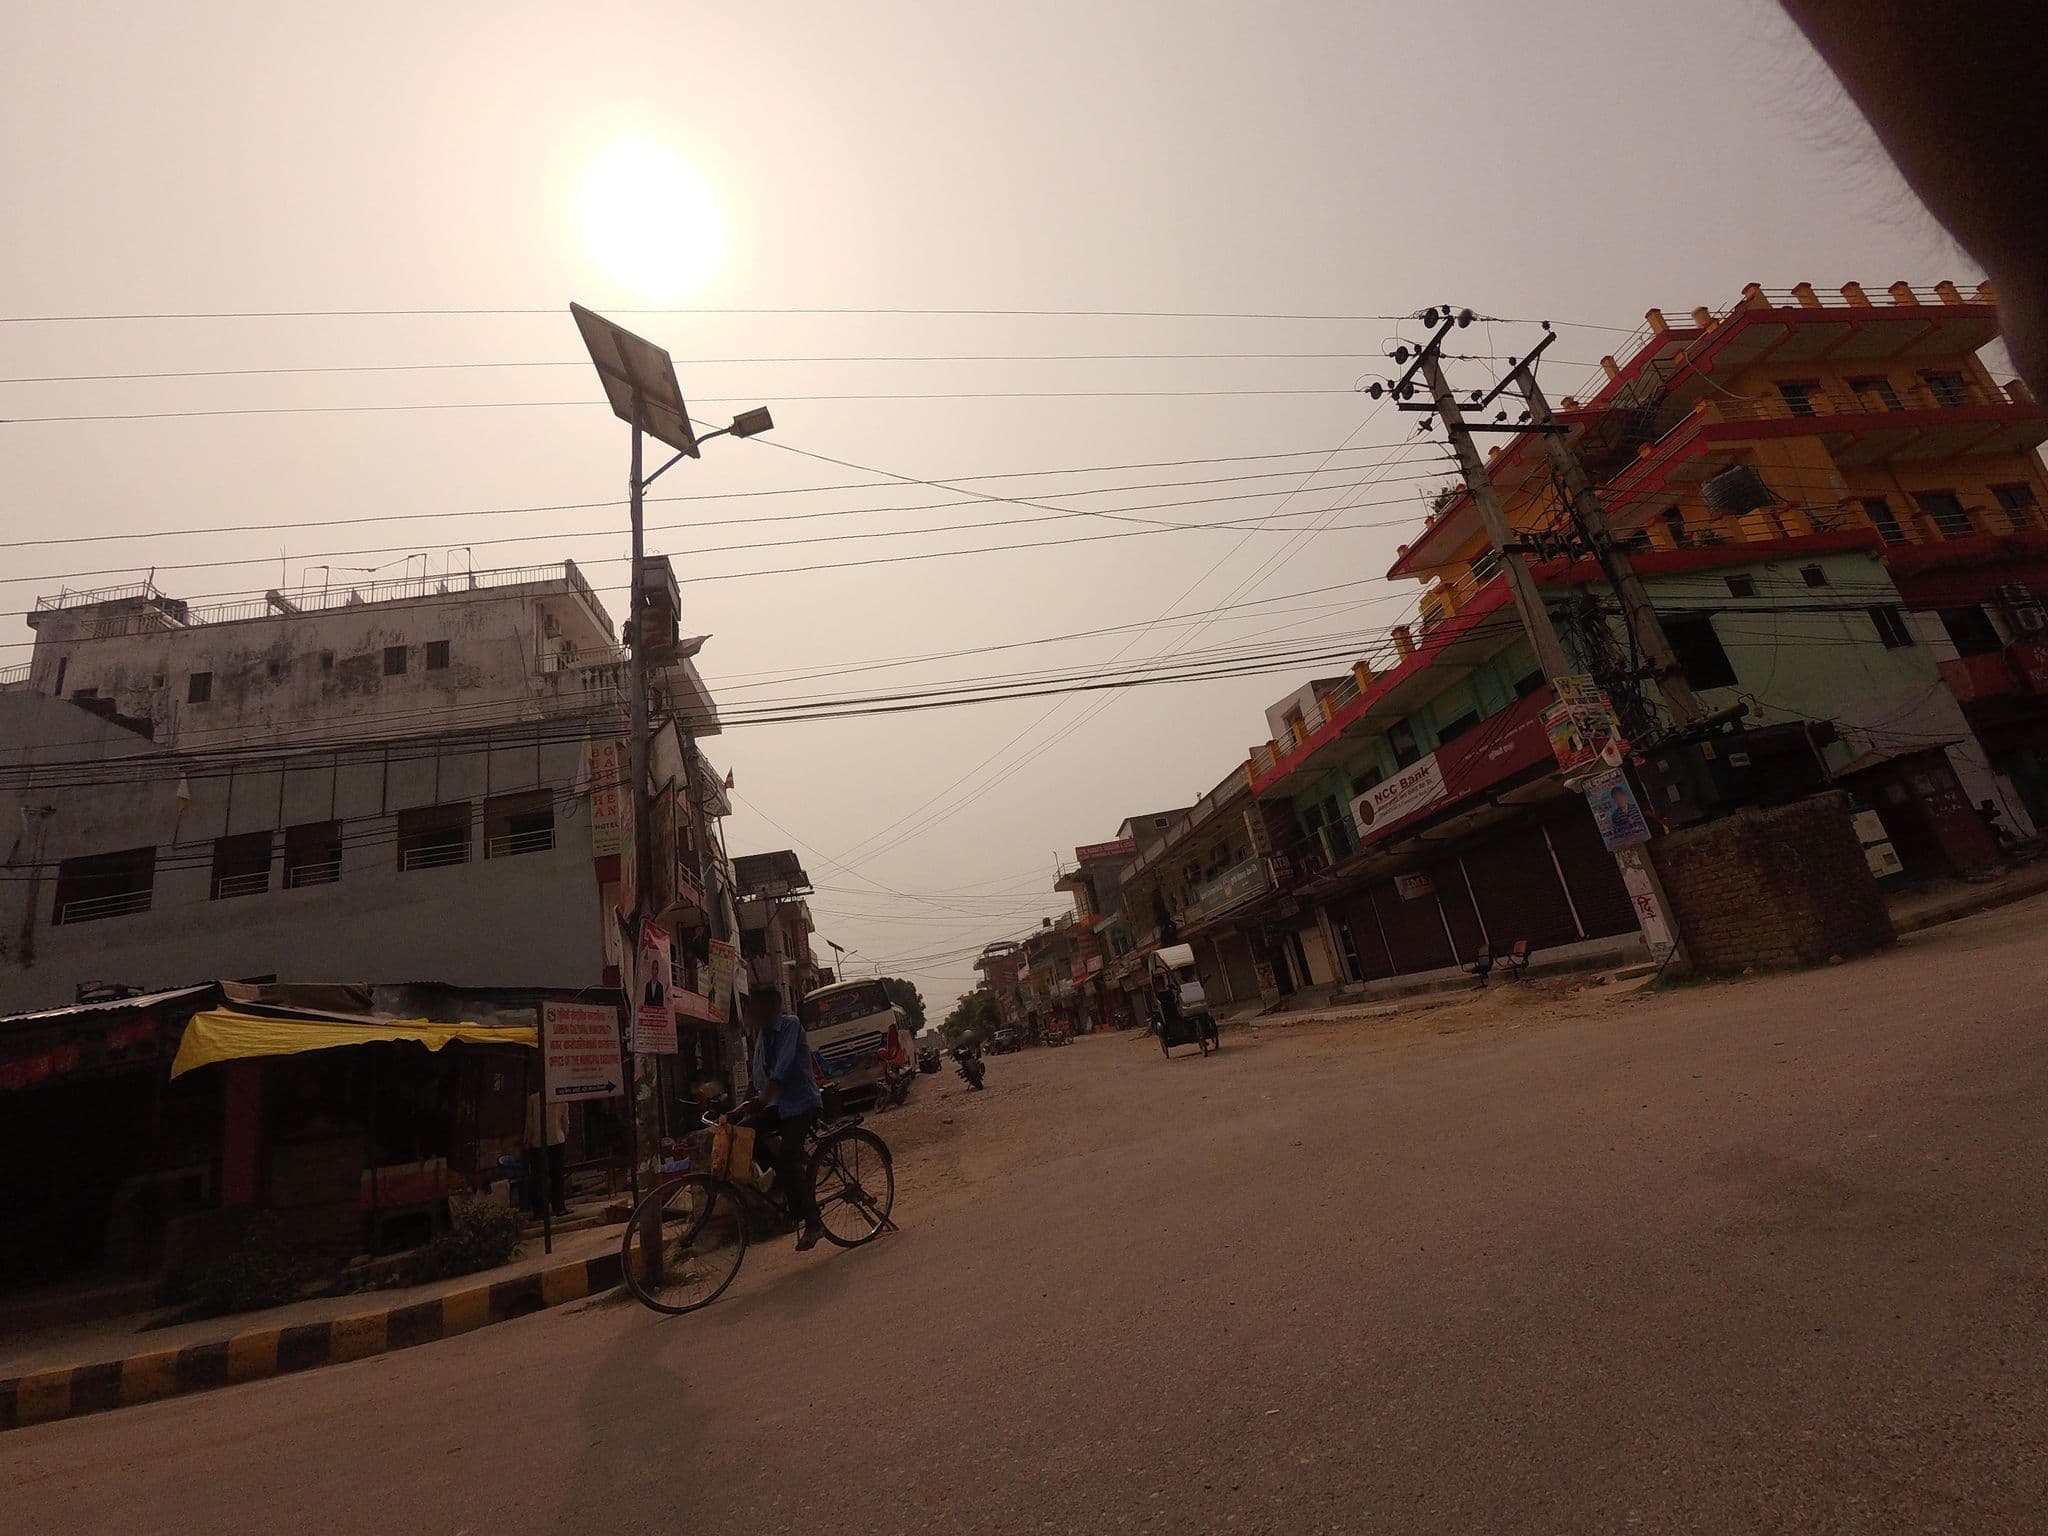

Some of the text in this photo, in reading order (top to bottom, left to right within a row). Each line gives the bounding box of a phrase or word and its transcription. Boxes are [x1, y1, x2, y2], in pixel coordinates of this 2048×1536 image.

[1374, 784, 1398, 803] NCC
[1399, 766, 1429, 789] Bank
[595, 822, 619, 831] HOTEL
